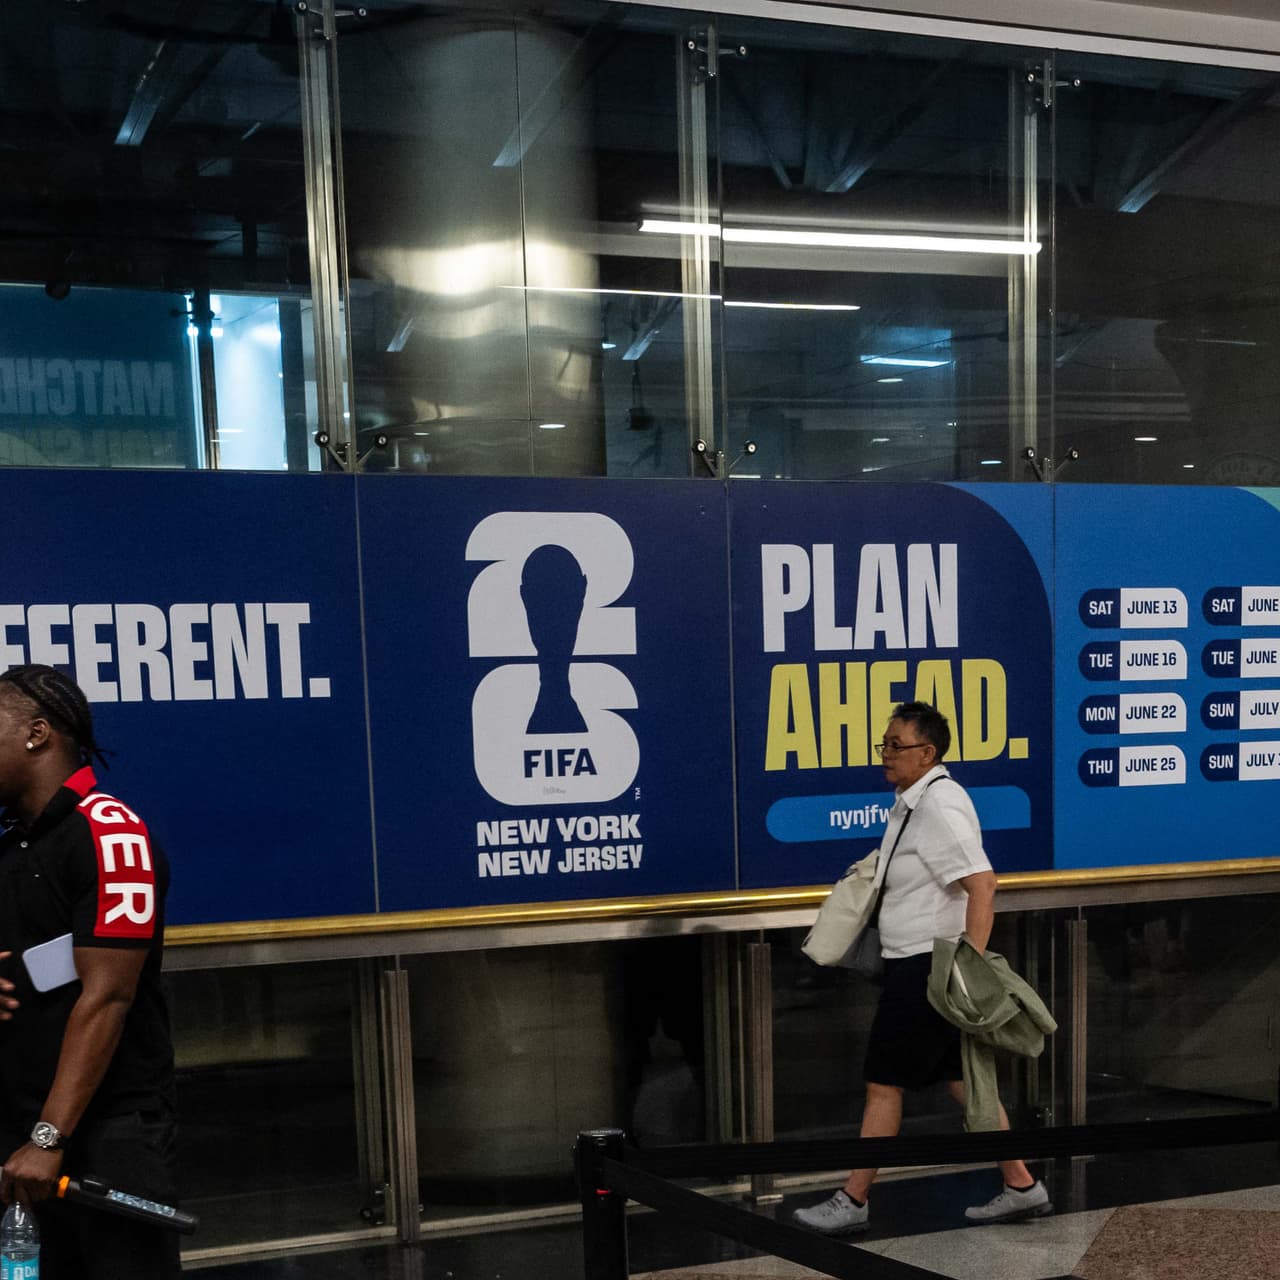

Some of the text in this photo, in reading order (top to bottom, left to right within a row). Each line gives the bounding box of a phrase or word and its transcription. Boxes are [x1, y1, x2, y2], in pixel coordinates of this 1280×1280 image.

[761, 543, 959, 653] PLAN
[1211, 598, 1236, 613] SAT
[1247, 598, 1279, 612] JUNE
[1088, 600, 1178, 615] SAT JUNE 13
[1088, 652, 1177, 668] TUE JUNE 16
[1211, 651, 1235, 665] TUE
[1246, 650, 1278, 664] JUNE
[1085, 705, 1176, 722] MON JUNE 22
[1209, 703, 1235, 717] SUN
[1249, 702, 1279, 716] JULY
[523, 747, 598, 778] FIFA
[1087, 757, 1176, 774] THU JUNE 25
[1208, 754, 1234, 769] SUN
[1246, 753, 1276, 767] JULY
[476, 814, 642, 847] NEW YORK
[477, 844, 643, 878] NEW JERSEY
